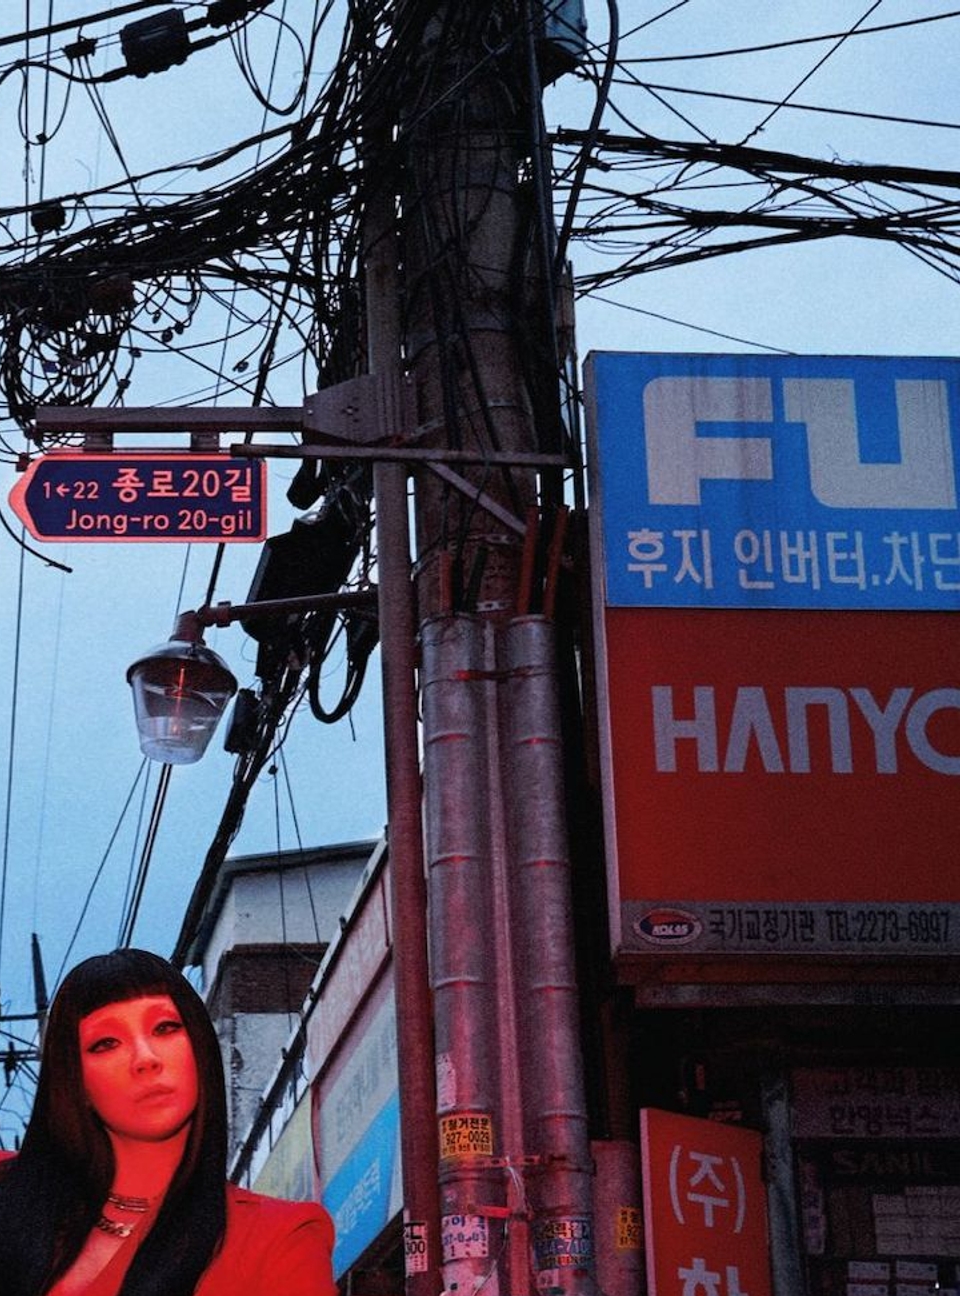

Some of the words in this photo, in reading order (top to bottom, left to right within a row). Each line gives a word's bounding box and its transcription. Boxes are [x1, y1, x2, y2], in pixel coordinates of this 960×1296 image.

[111, 467, 253, 503] 종로20길
[65, 508, 170, 535] Jong-ro
[177, 508, 253, 535] 20-gil
[626, 527, 715, 590] 후지
